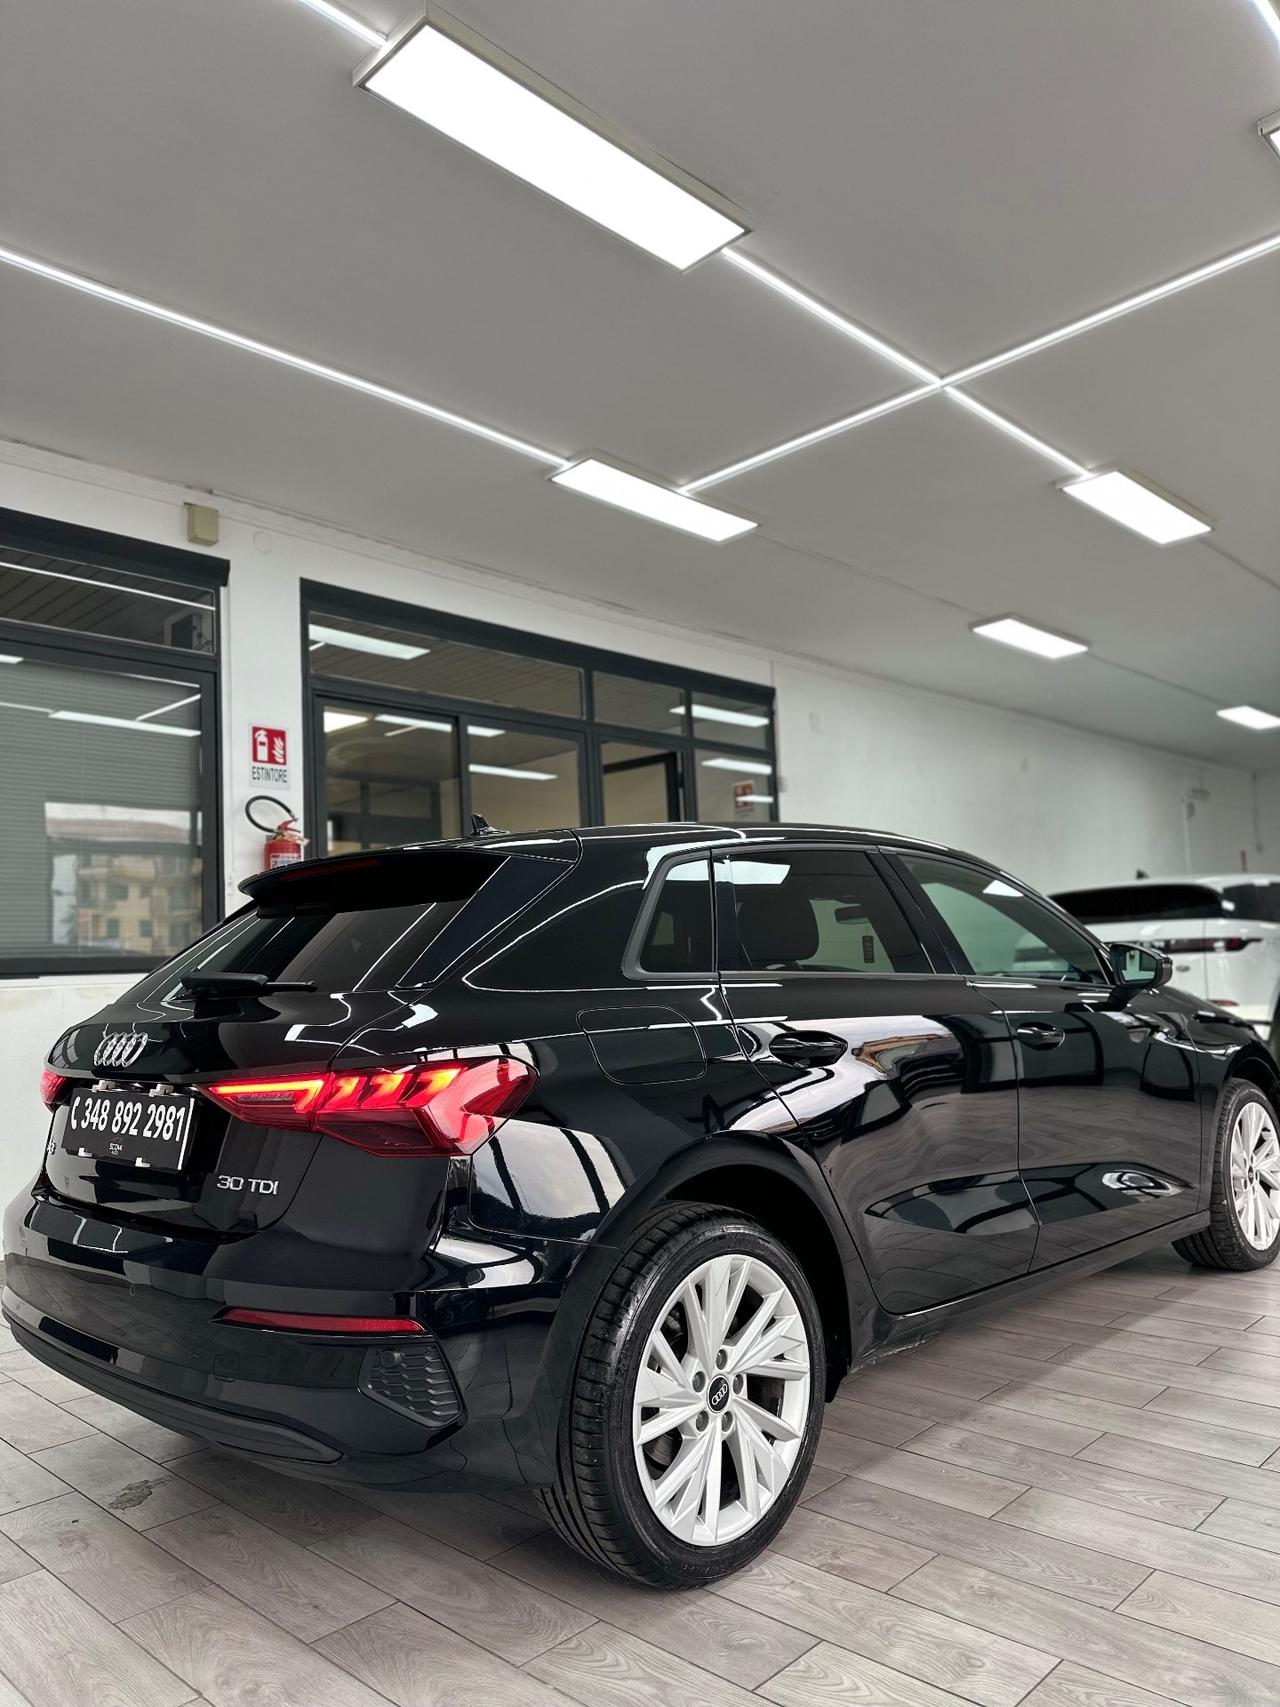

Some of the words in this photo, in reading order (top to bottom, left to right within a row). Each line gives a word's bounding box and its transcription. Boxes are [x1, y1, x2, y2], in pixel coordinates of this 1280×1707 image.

[252, 766, 287, 783] ESTINTORE
[80, 1097, 110, 1131] 348
[111, 1100, 142, 1136] 892
[142, 1103, 186, 1142] 2981
[217, 1174, 244, 1190] 30
[248, 1178, 279, 1195] TDI
